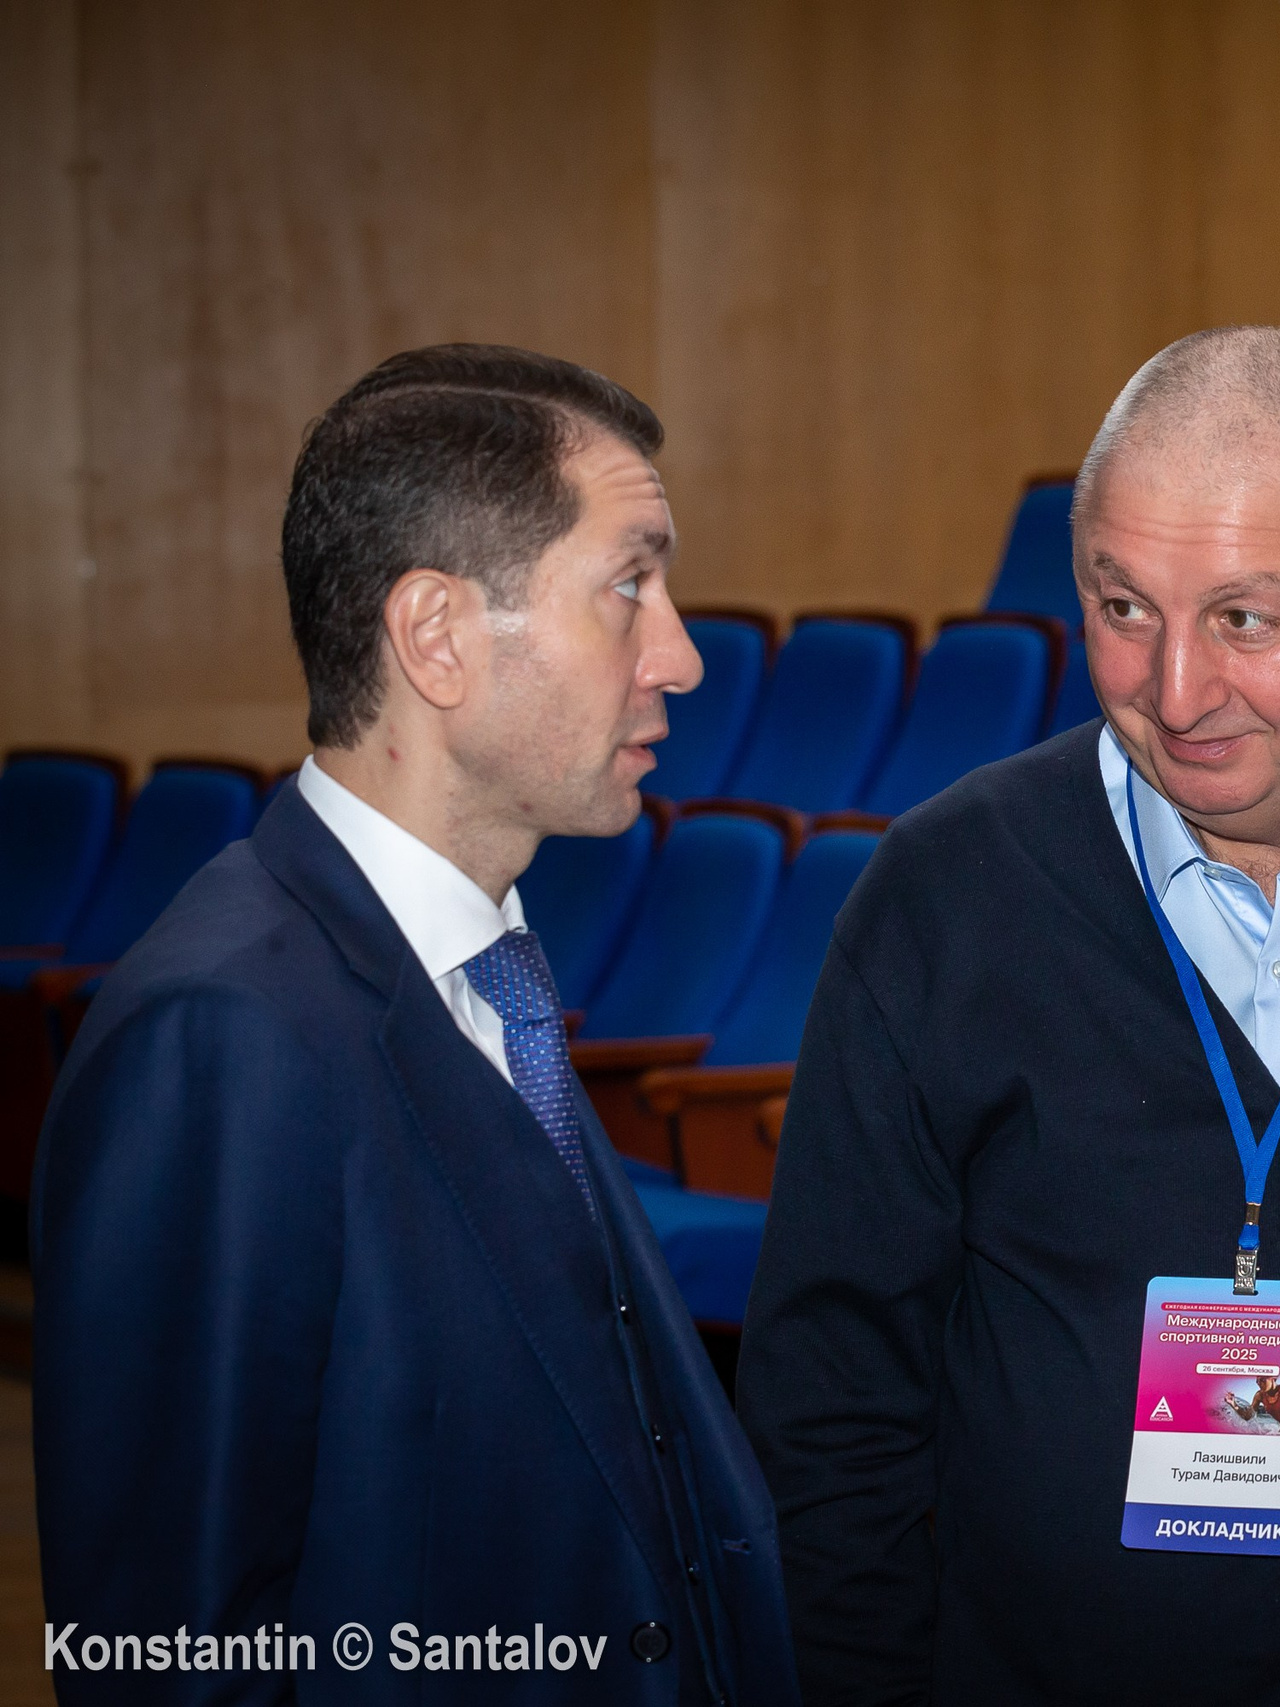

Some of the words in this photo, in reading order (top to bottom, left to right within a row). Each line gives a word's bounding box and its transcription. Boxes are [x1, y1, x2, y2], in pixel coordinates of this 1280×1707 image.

[1159, 1332, 1245, 1345] спортивной
[1221, 1347, 1258, 1360] 2025
[1212, 1366, 1246, 1374] сентября,
[1192, 1451, 1266, 1465] Лазишвили
[1171, 1468, 1210, 1482] Турам
